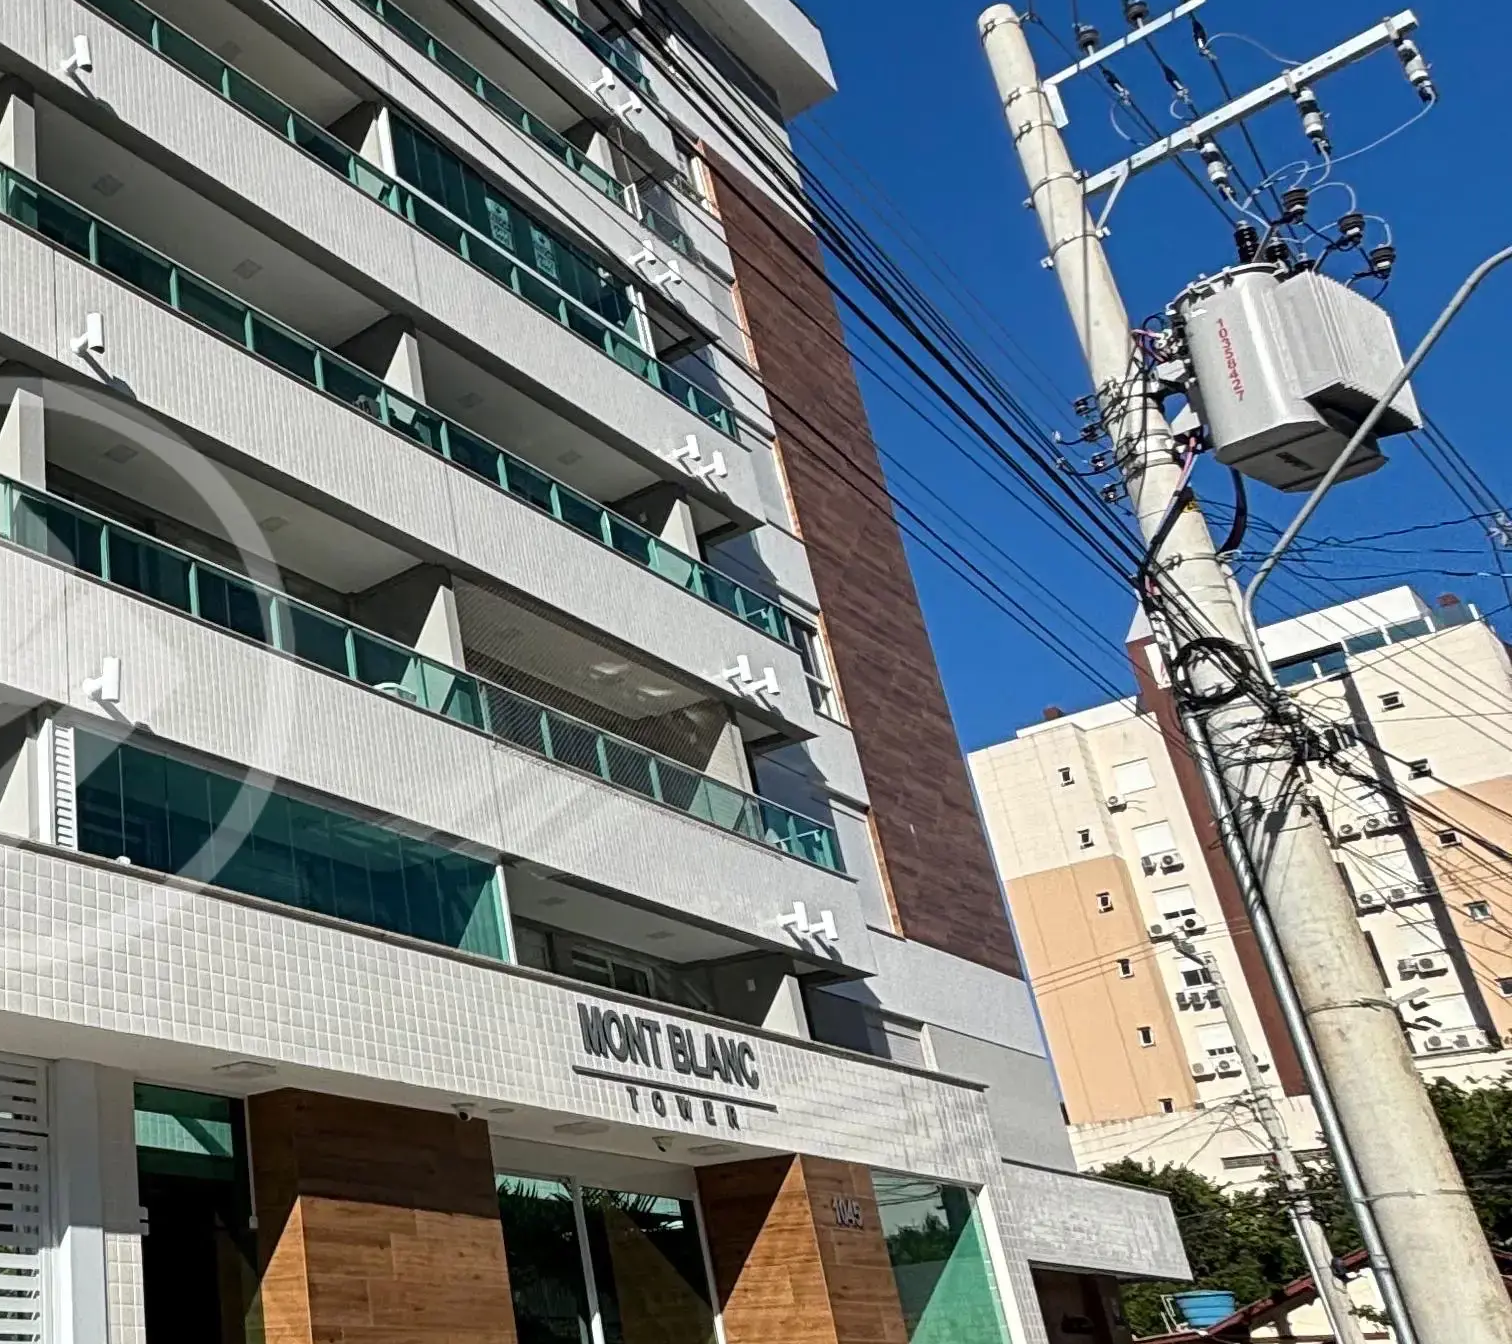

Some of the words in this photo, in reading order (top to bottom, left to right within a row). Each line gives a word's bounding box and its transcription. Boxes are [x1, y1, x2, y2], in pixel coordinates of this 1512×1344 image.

[576, 1001, 663, 1070] MONT
[666, 1023, 760, 1090] BLANC
[625, 1086, 741, 1132] TOWER
